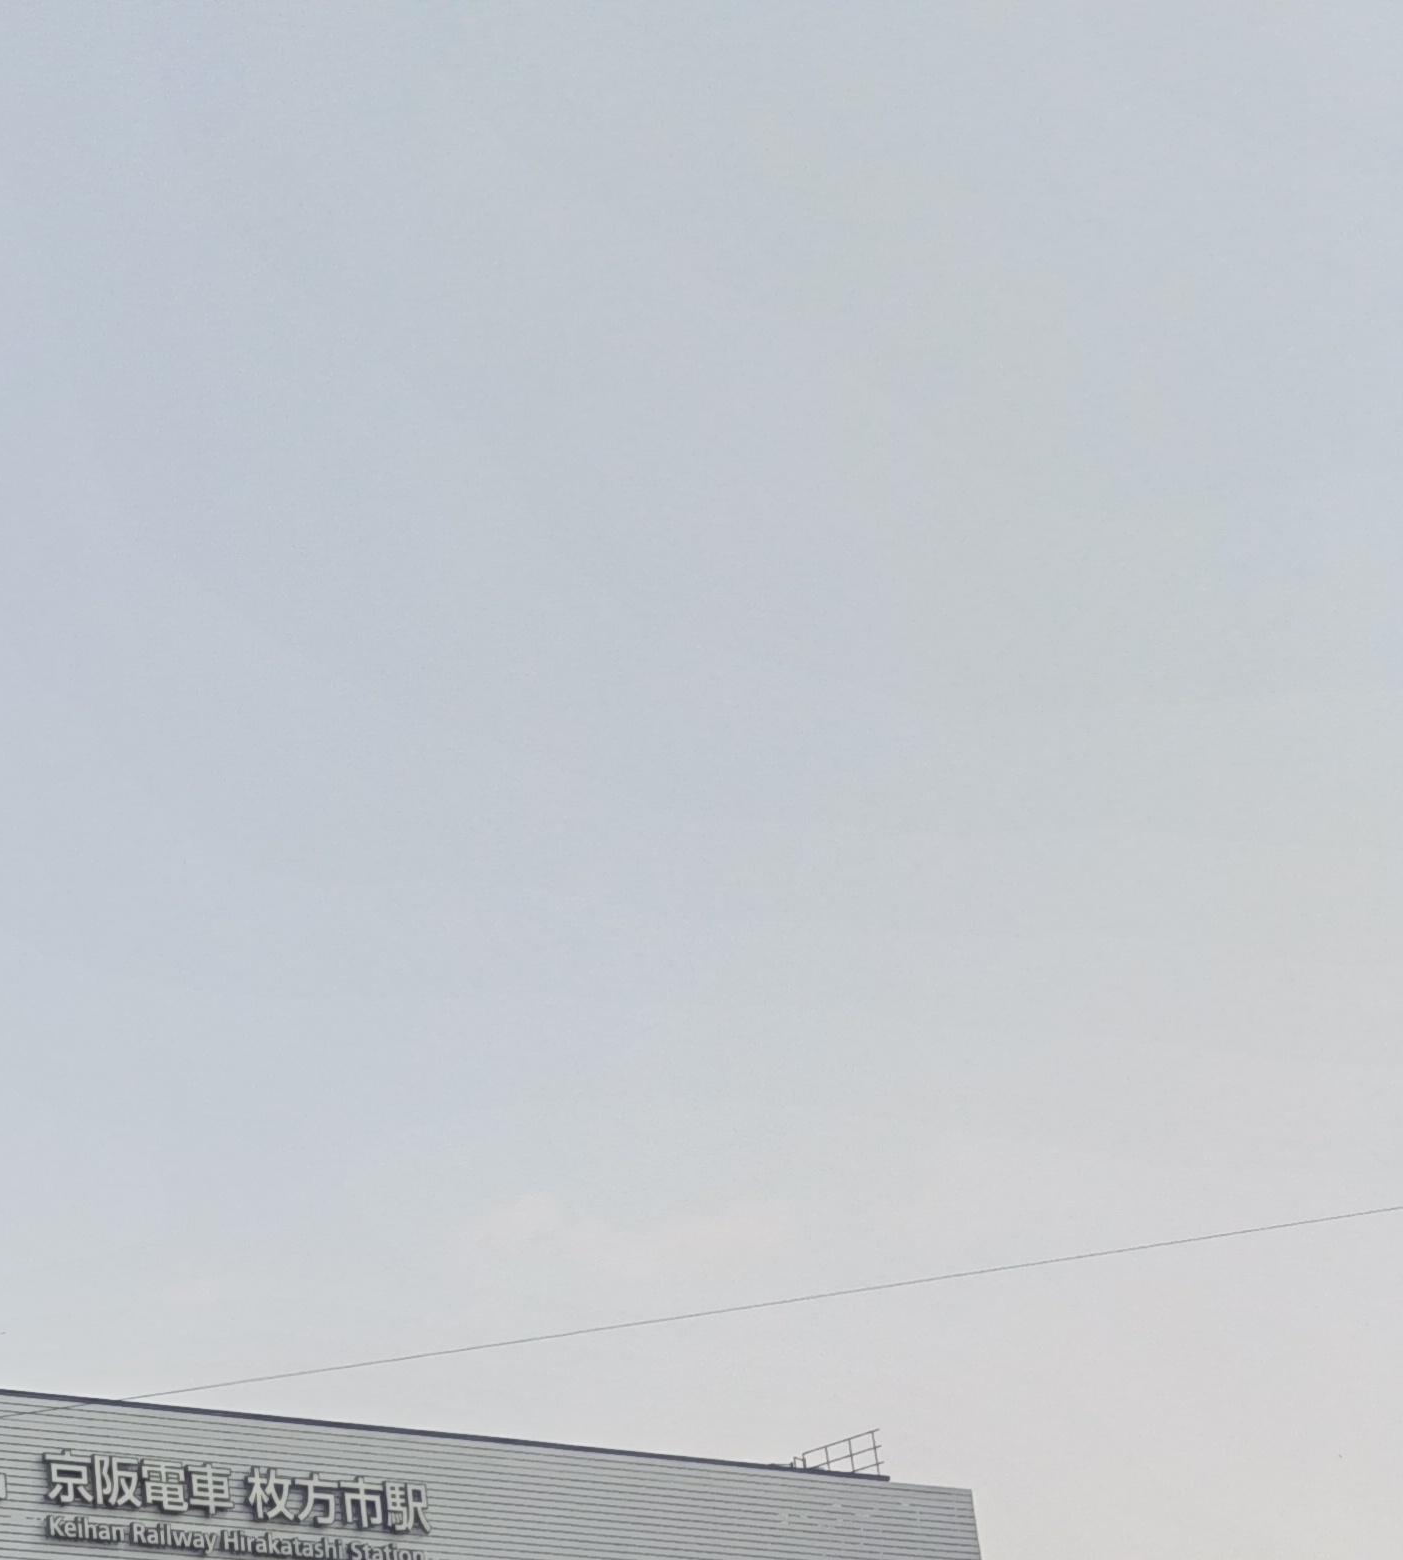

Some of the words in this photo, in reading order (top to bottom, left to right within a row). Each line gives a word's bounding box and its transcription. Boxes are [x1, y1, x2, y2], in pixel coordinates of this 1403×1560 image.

[42, 1450, 235, 1515] 京阪電車
[245, 1466, 433, 1535] 枚方市駅
[46, 1514, 126, 1542] Keihan
[130, 1522, 217, 1556] Railway
[222, 1530, 344, 1560] Hirakatashi
